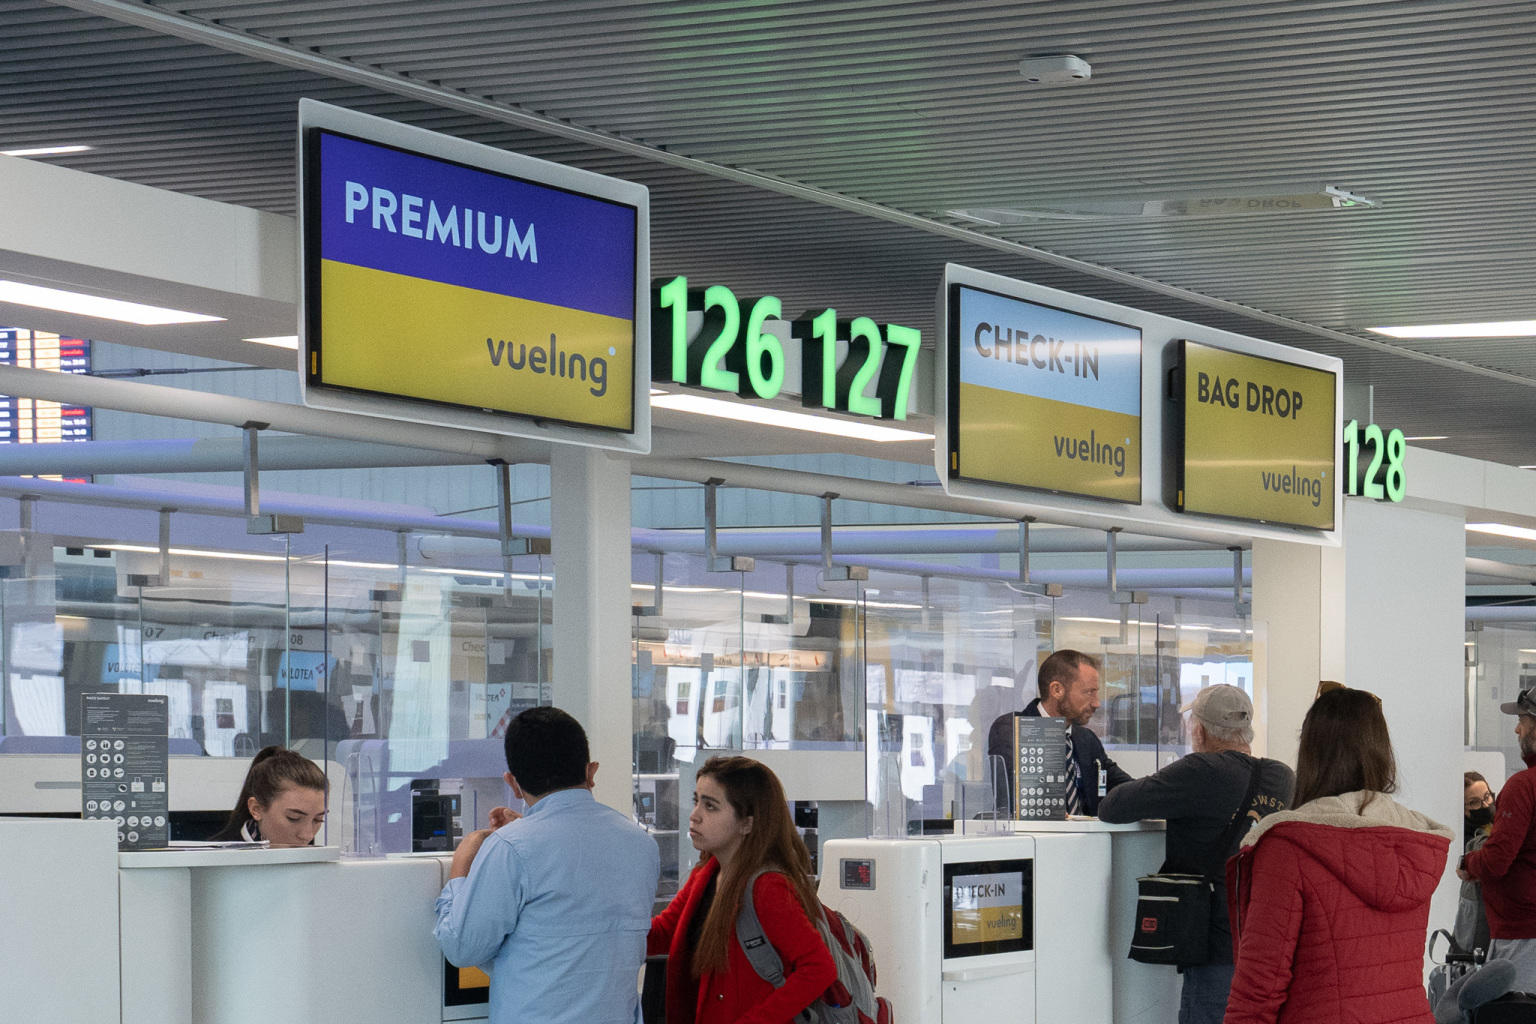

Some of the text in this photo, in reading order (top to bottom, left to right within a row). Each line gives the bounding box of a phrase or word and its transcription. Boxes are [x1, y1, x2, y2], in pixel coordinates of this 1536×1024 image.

[345, 180, 538, 264] PREMIUM
[486, 333, 608, 398] vueling
[660, 275, 921, 421] 126 127
[974, 321, 1100, 382] CHECK-IN
[1197, 372, 1304, 420] BAG DROP
[1053, 429, 1126, 478] vueling
[1344, 419, 1407, 503] 128
[1261, 465, 1322, 507] vueling
[281, 668, 314, 680] VLOTEA
[987, 914, 1017, 931] vueling
